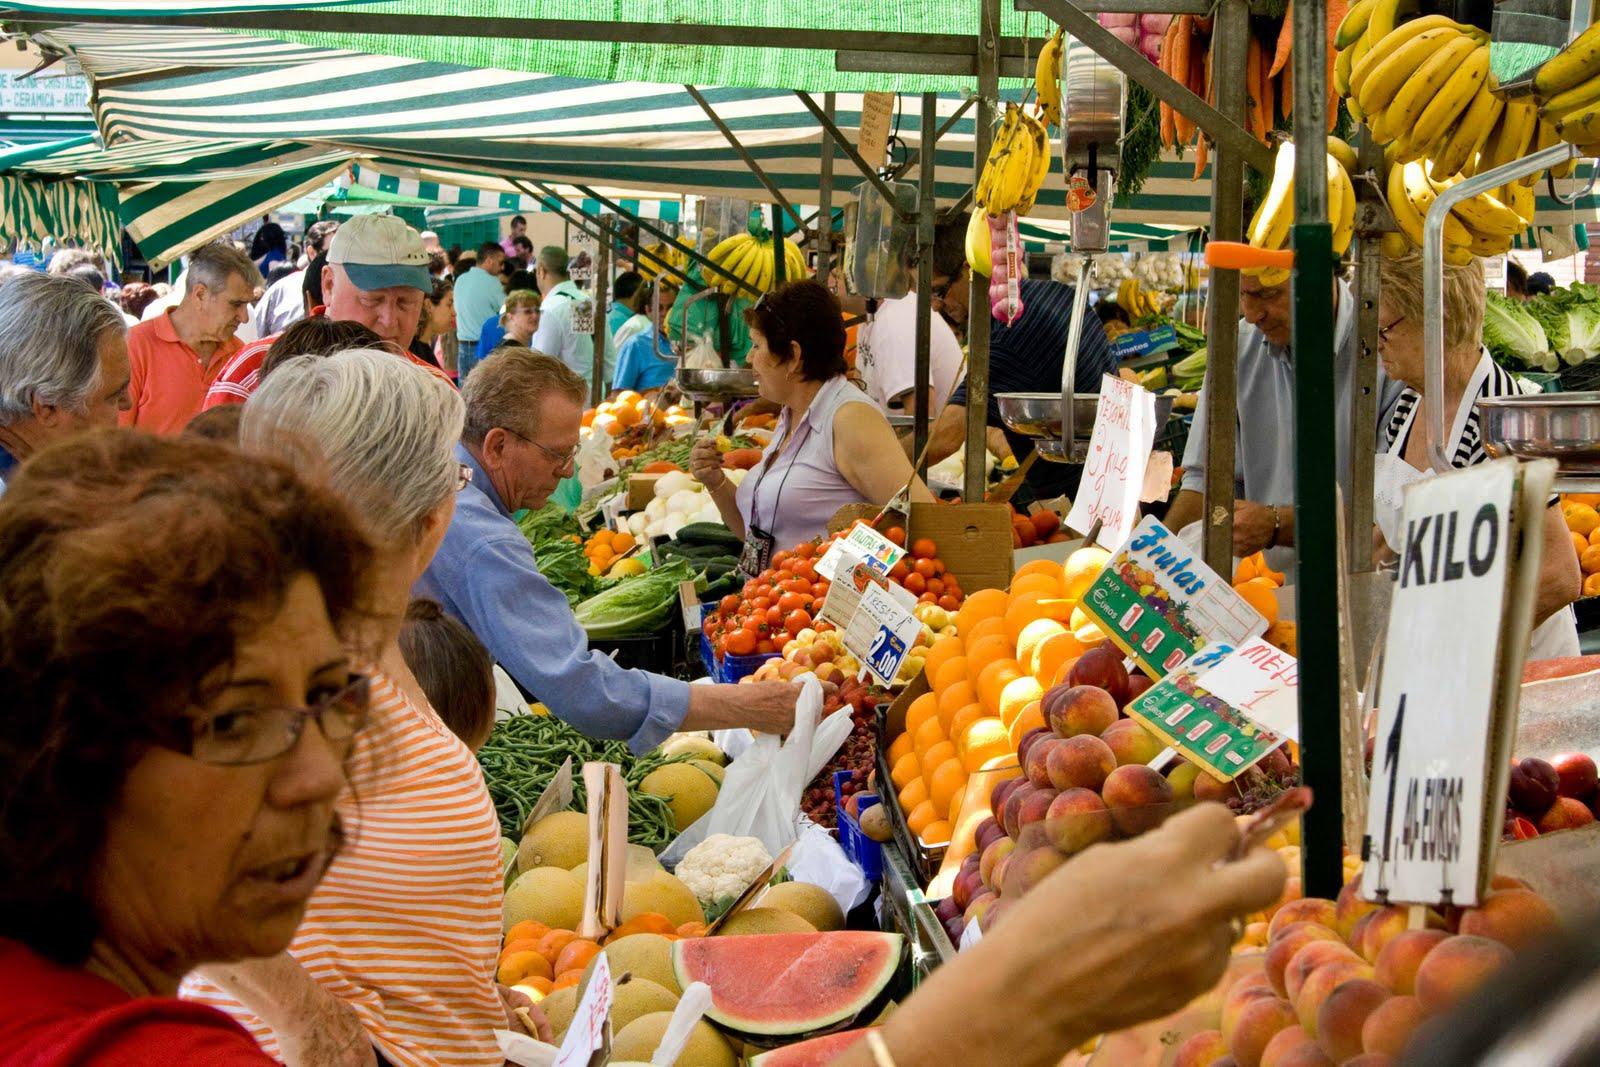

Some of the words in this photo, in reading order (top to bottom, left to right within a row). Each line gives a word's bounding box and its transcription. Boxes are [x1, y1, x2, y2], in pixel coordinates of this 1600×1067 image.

[1131, 525, 1205, 595] Frutas
[1401, 503, 1499, 588] KILO
[1421, 777, 1463, 863] EUROS
